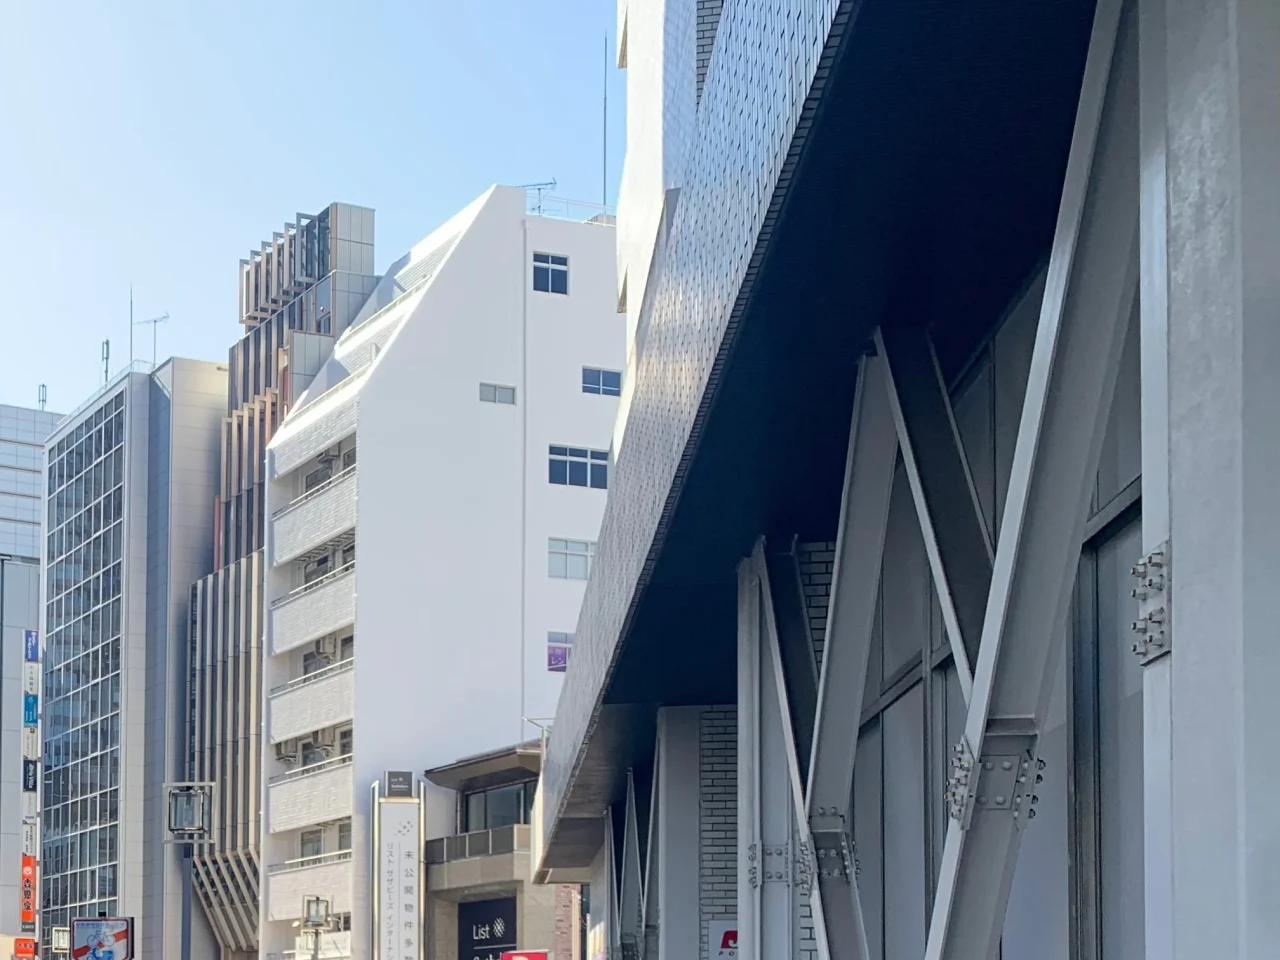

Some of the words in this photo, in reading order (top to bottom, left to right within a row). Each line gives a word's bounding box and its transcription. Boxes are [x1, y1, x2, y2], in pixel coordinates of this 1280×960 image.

[386, 842, 395, 867] リスト
[473, 924, 490, 940] List
